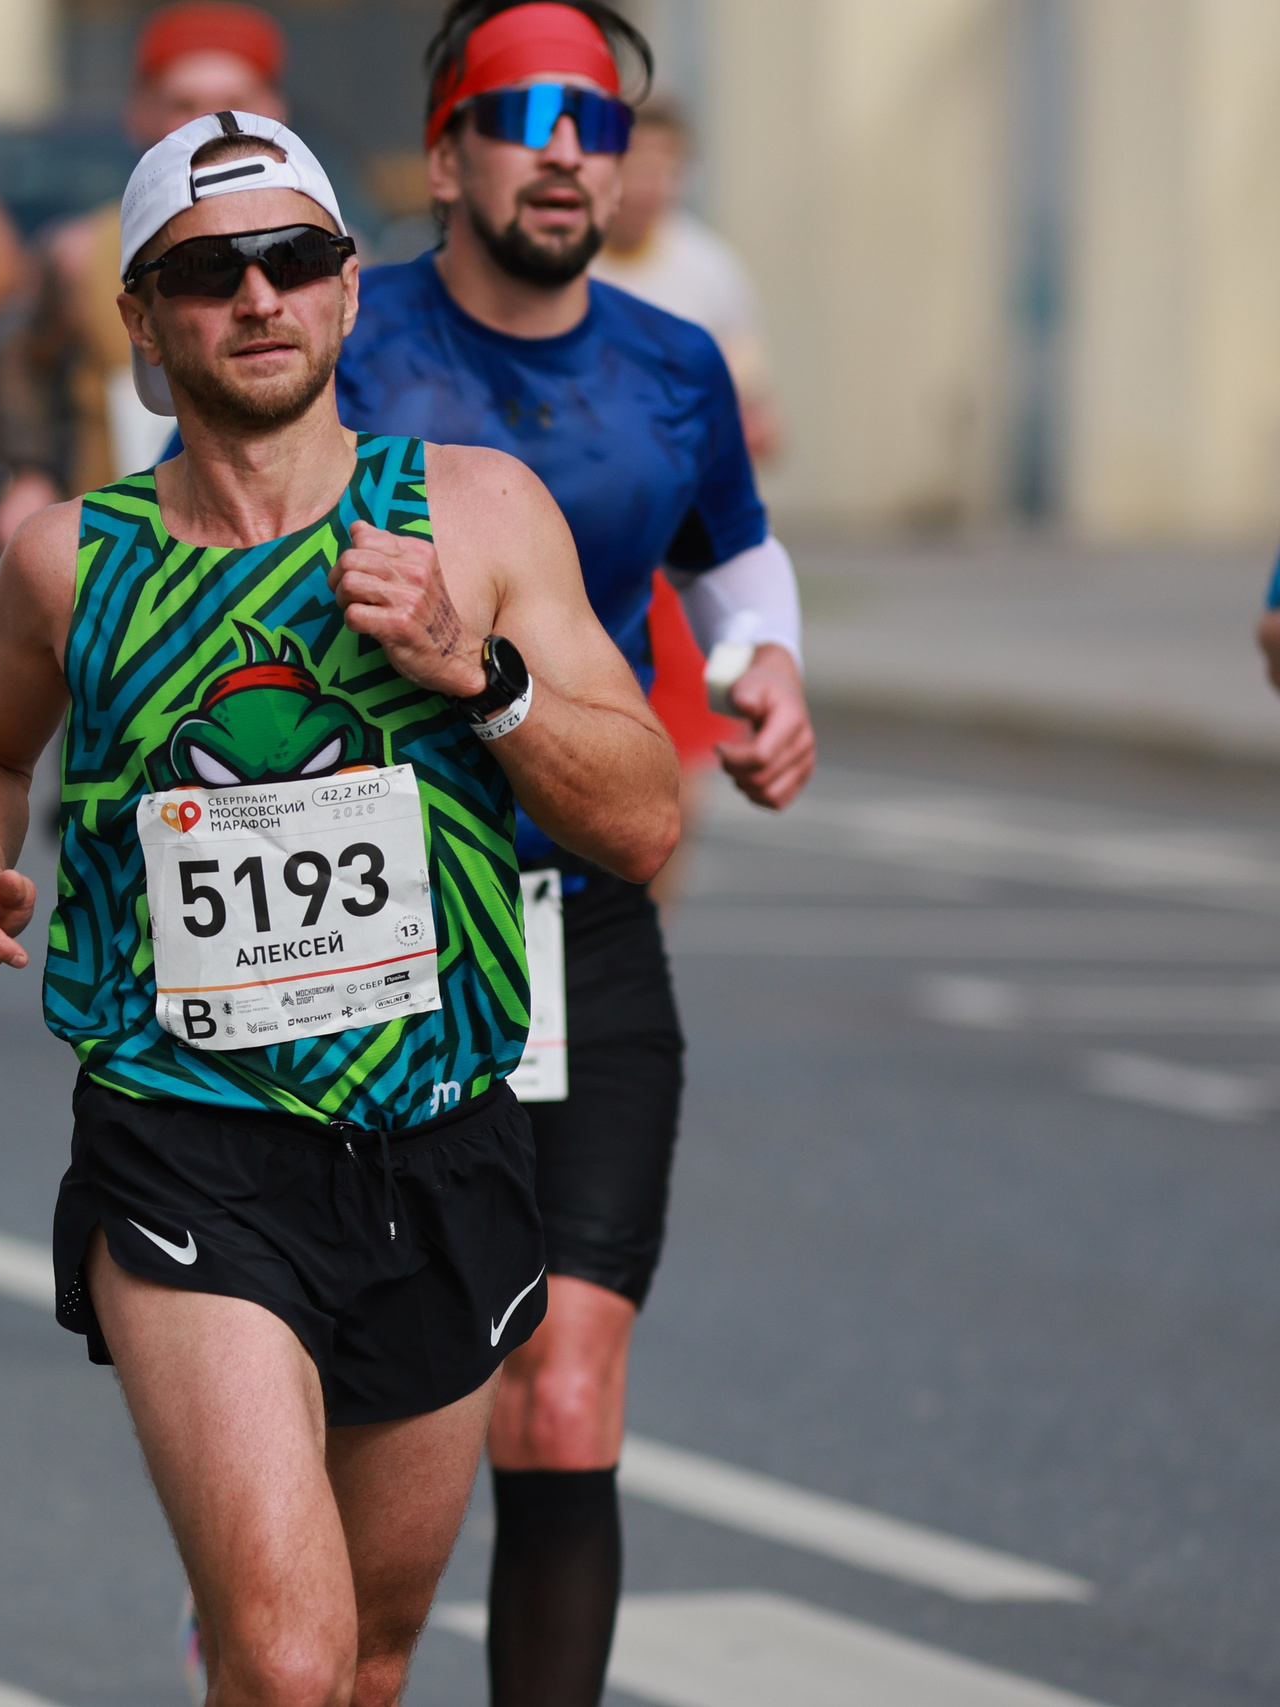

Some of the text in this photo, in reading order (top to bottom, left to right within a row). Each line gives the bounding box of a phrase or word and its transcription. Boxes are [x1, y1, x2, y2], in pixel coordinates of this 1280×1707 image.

[321, 782, 380, 802] 42,2 КМ
[207, 793, 278, 806] СБЕРПРАЙМ
[209, 800, 305, 819] МОСКОВСКИЙ
[332, 802, 376, 820] 2026
[211, 817, 281, 832] МАРАФОН
[178, 842, 390, 938] 5193
[400, 923, 419, 937] 13
[235, 930, 345, 968] АЛЕКСЕЙ
[295, 984, 335, 996] МОСКОВСКИЙ
[359, 979, 383, 991] СБЕР
[296, 995, 315, 1006] СПОРТ
[377, 995, 404, 1008] WINLINE
[258, 1024, 279, 1033] BRICS
